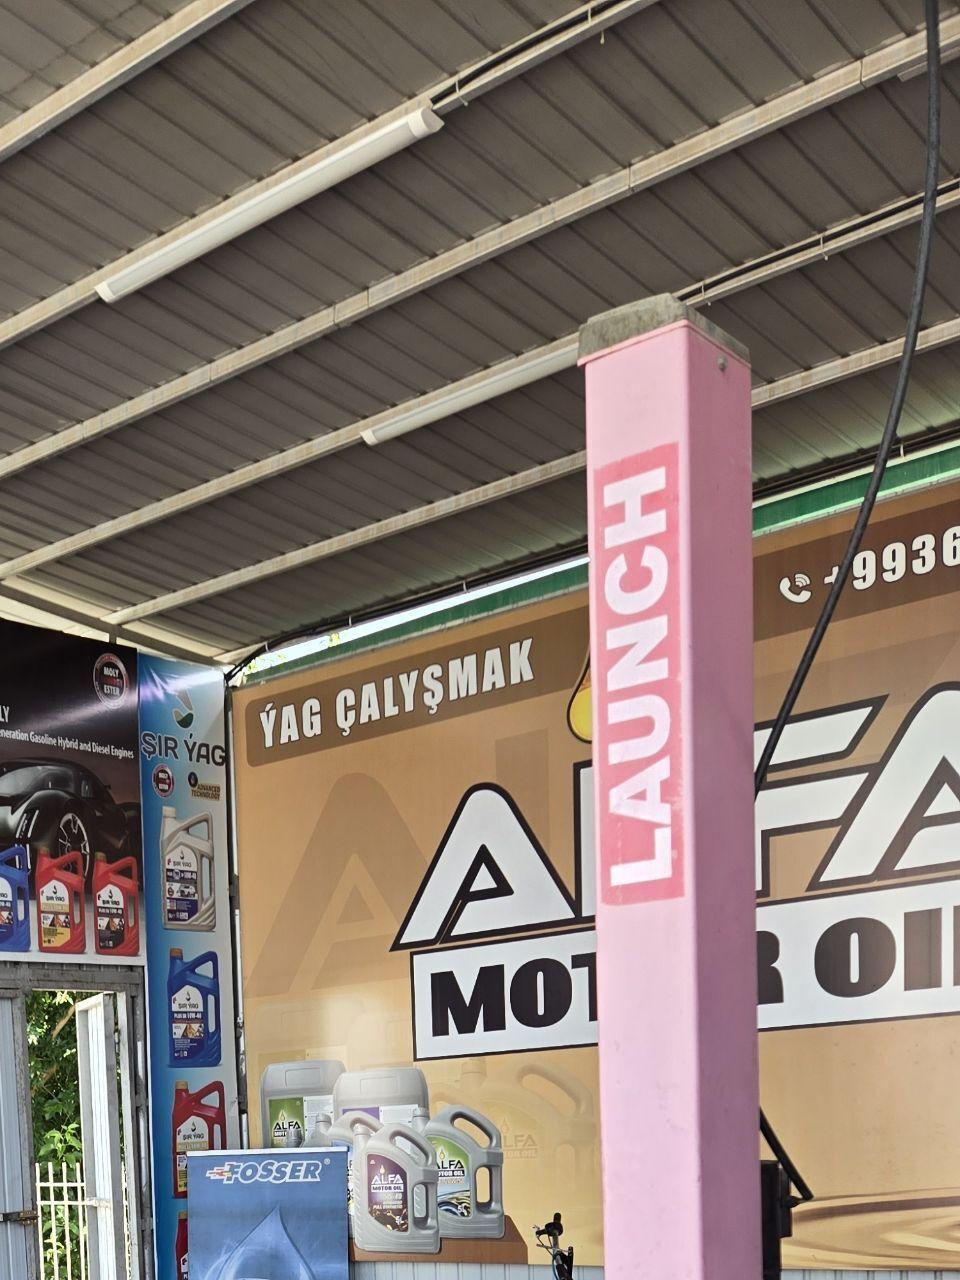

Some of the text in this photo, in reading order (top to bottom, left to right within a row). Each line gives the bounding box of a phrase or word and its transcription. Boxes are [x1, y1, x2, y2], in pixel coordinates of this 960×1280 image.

[603, 465, 672, 888] LAUNCH
[259, 638, 534, 748] ÝAG ÇALYŞMAK
[30, 731, 57, 746] Gasoline
[58, 736, 78, 750] Hybrid
[80, 741, 91, 752] and
[92, 742, 110, 755] Diesel
[111, 746, 134, 760] Engines
[141, 731, 225, 766] ŞIR ÝAG
[391, 682, 960, 949] AFA
[815, 906, 960, 998] OI
[273, 1120, 301, 1130] ALFA
[504, 1134, 538, 1148] LFA
[223, 1159, 322, 1185] FOSSER
[371, 1173, 404, 1185] ALFA
